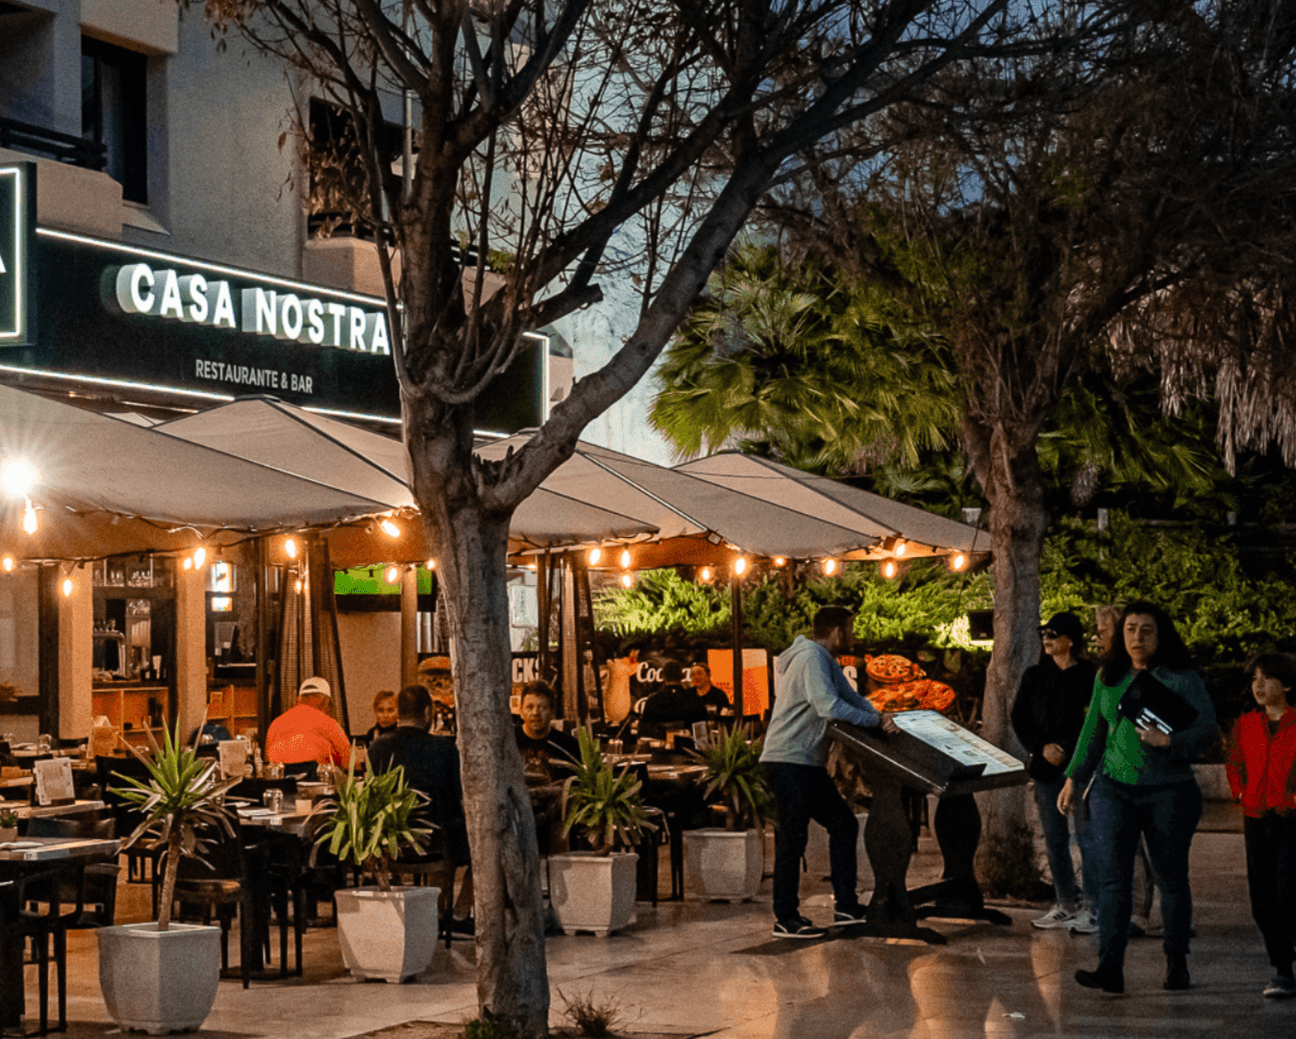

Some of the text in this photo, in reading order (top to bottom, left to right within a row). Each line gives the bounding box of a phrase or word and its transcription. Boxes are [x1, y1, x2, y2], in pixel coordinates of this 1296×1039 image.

[116, 263, 391, 356] CASA NOSTRA
[194, 358, 314, 394] RESTAURANTE & BAR
